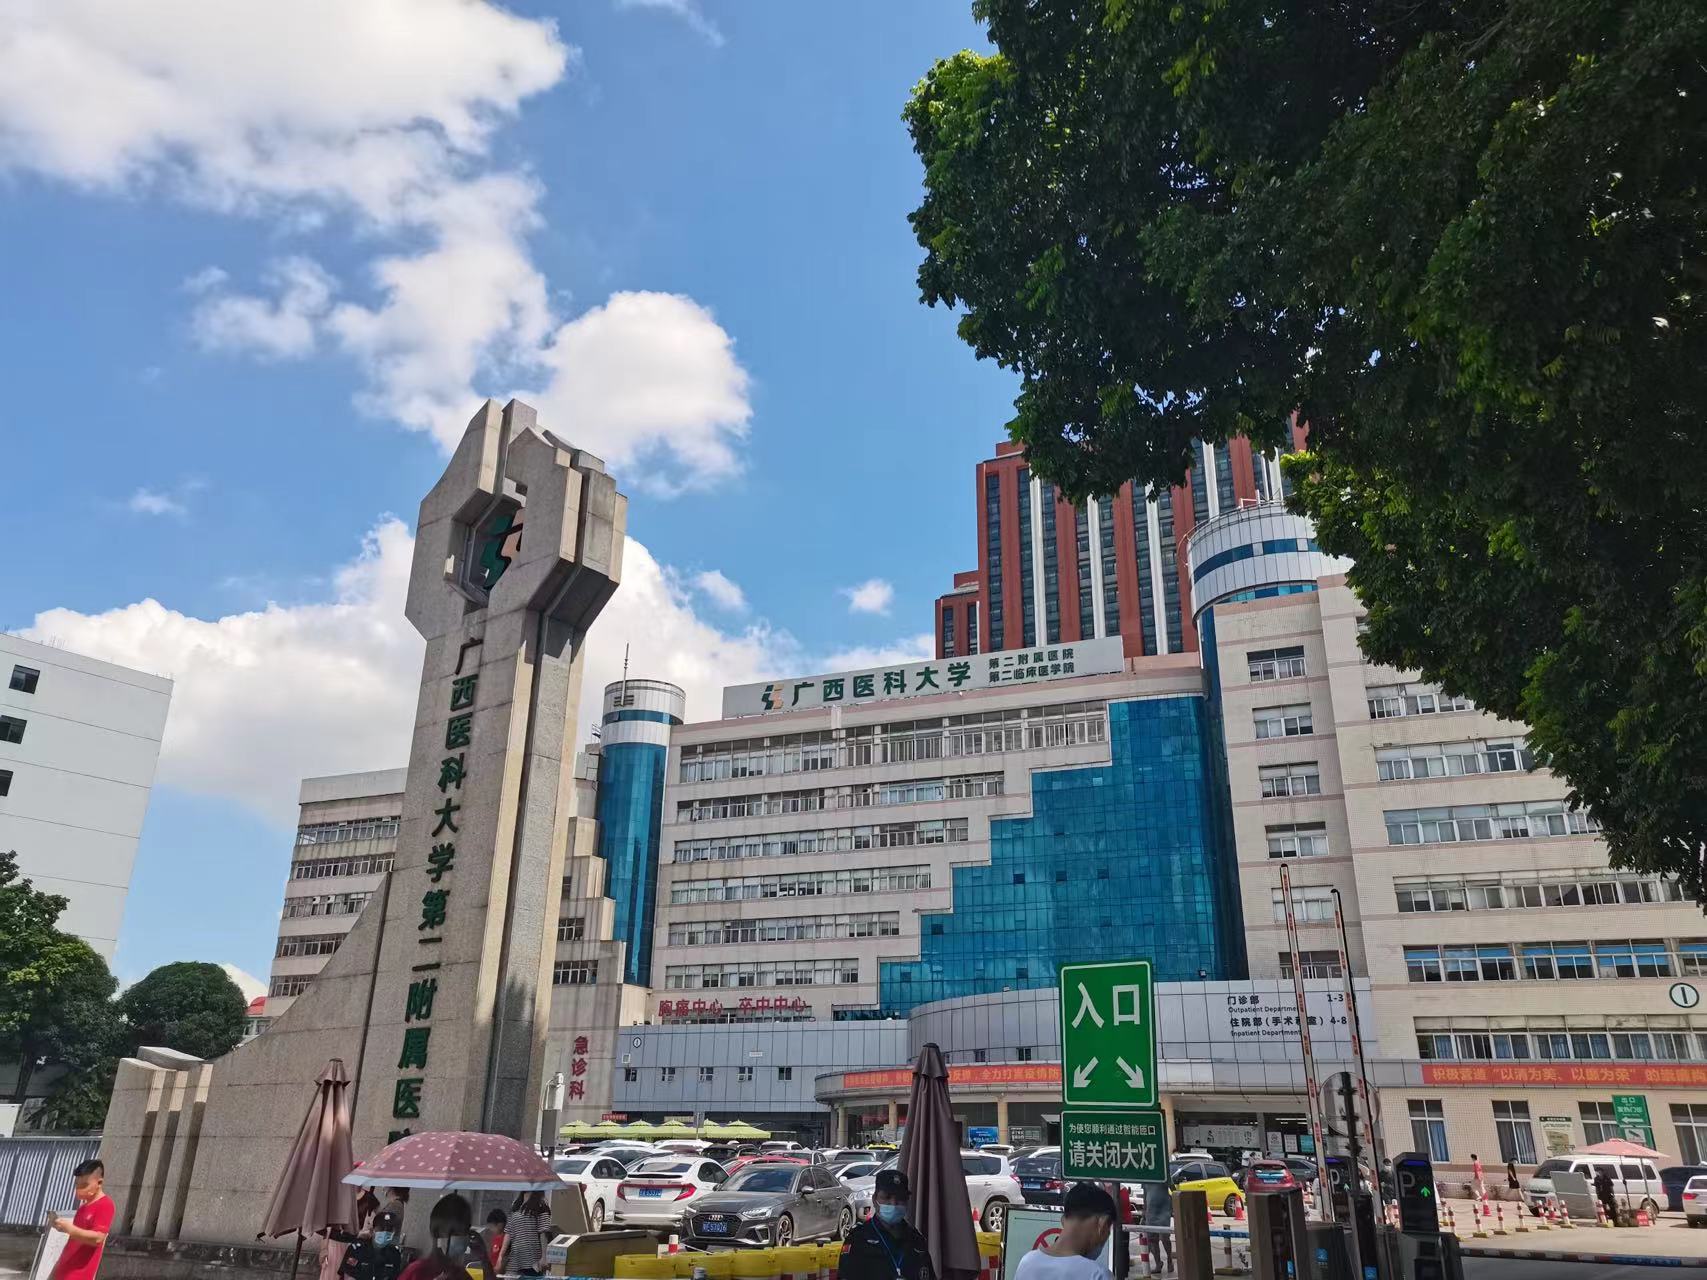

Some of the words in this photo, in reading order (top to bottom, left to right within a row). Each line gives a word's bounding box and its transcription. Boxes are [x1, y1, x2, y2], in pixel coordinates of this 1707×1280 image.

[988, 647, 1075, 670] 第二附属医院
[792, 660, 972, 706] 广西医科大学
[988, 660, 1076, 683] 第二临床医学院
[658, 998, 723, 1017] 胸痛中心
[739, 995, 808, 1015] 卒中中心
[1071, 981, 1141, 1029] 入口
[1227, 995, 1260, 1006] 门诊部
[1228, 1006, 1263, 1014] Outpatient
[1231, 1029, 1260, 1037] Inpatient
[568, 1035, 589, 1100] 急诊科
[1068, 1139, 1157, 1170] 请关闭大灯
